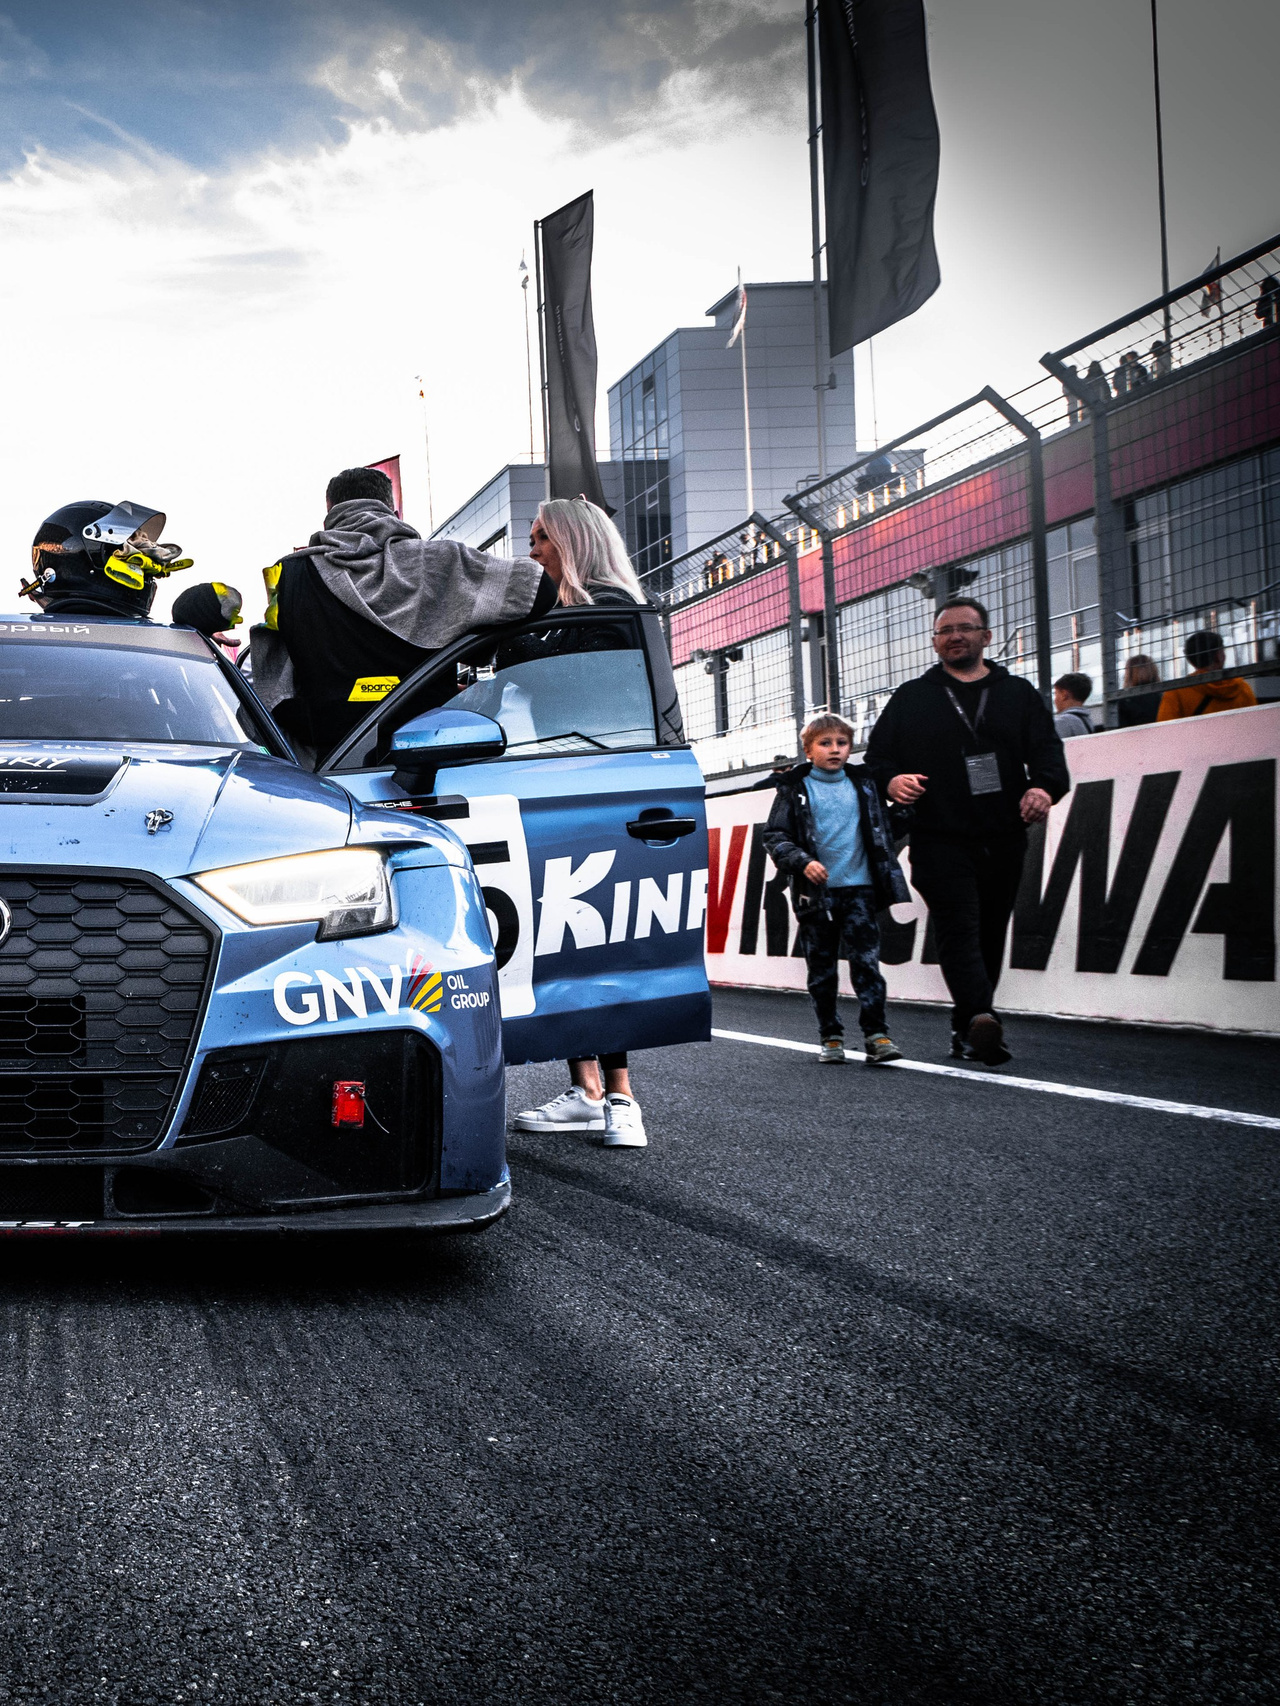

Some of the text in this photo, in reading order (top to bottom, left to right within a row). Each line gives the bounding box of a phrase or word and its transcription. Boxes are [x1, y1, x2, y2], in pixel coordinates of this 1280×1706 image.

[446, 974, 469, 990] OIL
[273, 964, 403, 1026] GNV
[450, 991, 490, 1010] GROUP
